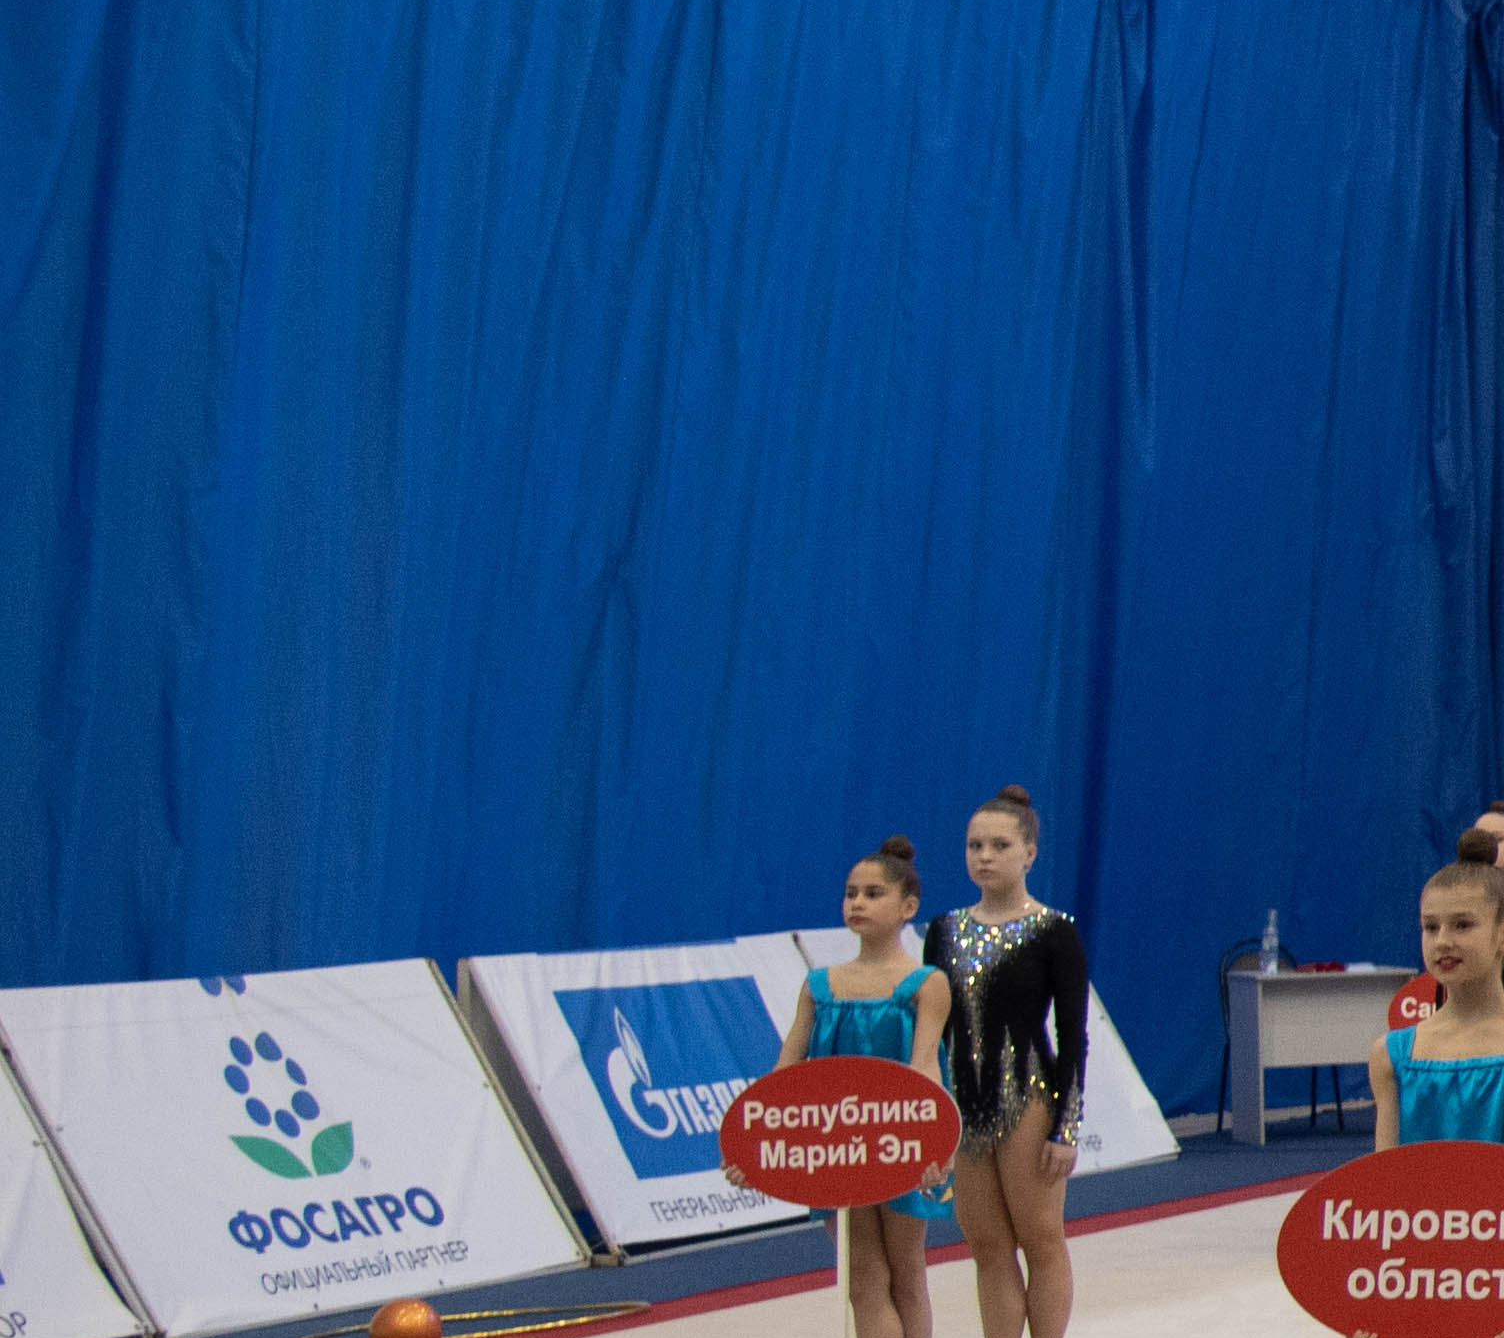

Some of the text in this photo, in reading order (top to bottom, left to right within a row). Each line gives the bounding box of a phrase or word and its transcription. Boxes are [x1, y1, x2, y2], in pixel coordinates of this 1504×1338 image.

[742, 1095, 937, 1135] Республика
[760, 1135, 922, 1174] Марий Эл
[228, 1186, 445, 1254] ФОСАГРО
[260, 1240, 470, 1297] ОФИЦИАЛЬНЫЙ ПАРТНЕР
